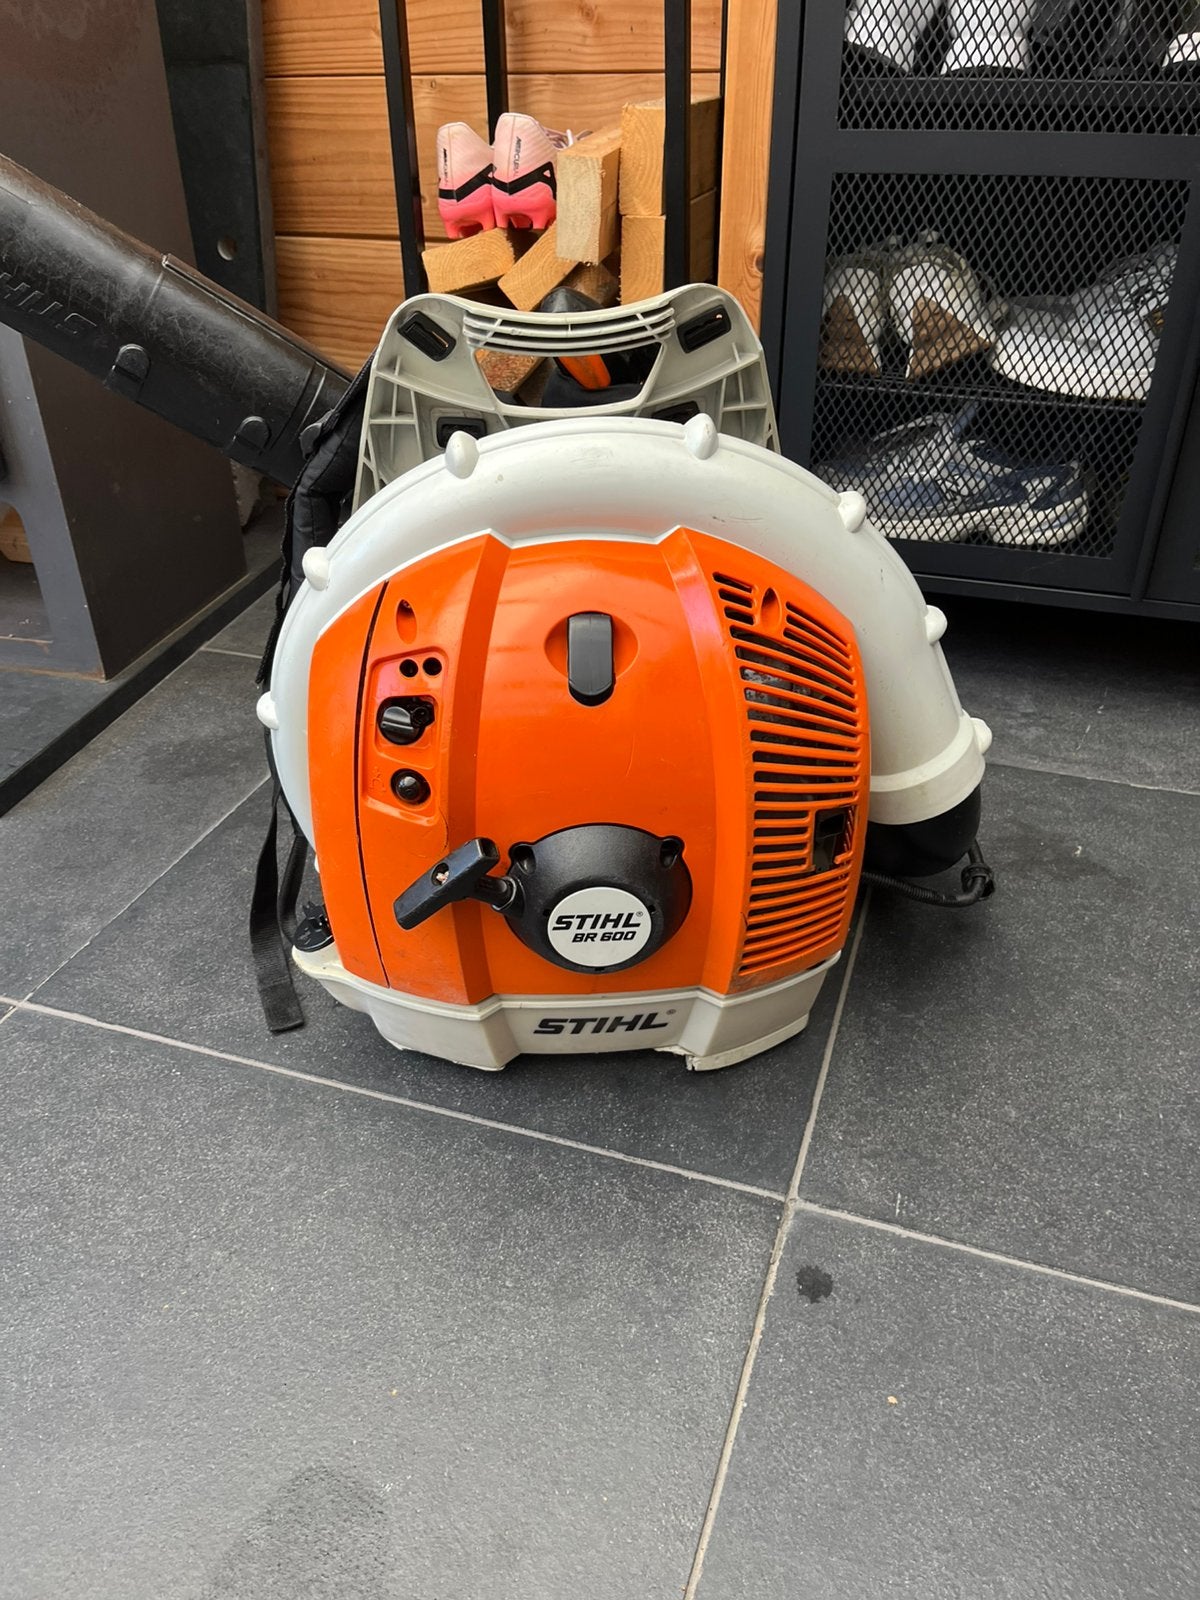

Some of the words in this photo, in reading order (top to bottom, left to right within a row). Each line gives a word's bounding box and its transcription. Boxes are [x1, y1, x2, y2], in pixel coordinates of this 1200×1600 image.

[0, 271, 98, 335] STIH
[552, 912, 641, 931] STIHL
[572, 932, 596, 943] BR
[600, 931, 637, 942] 600
[533, 1012, 669, 1035] STIHL
